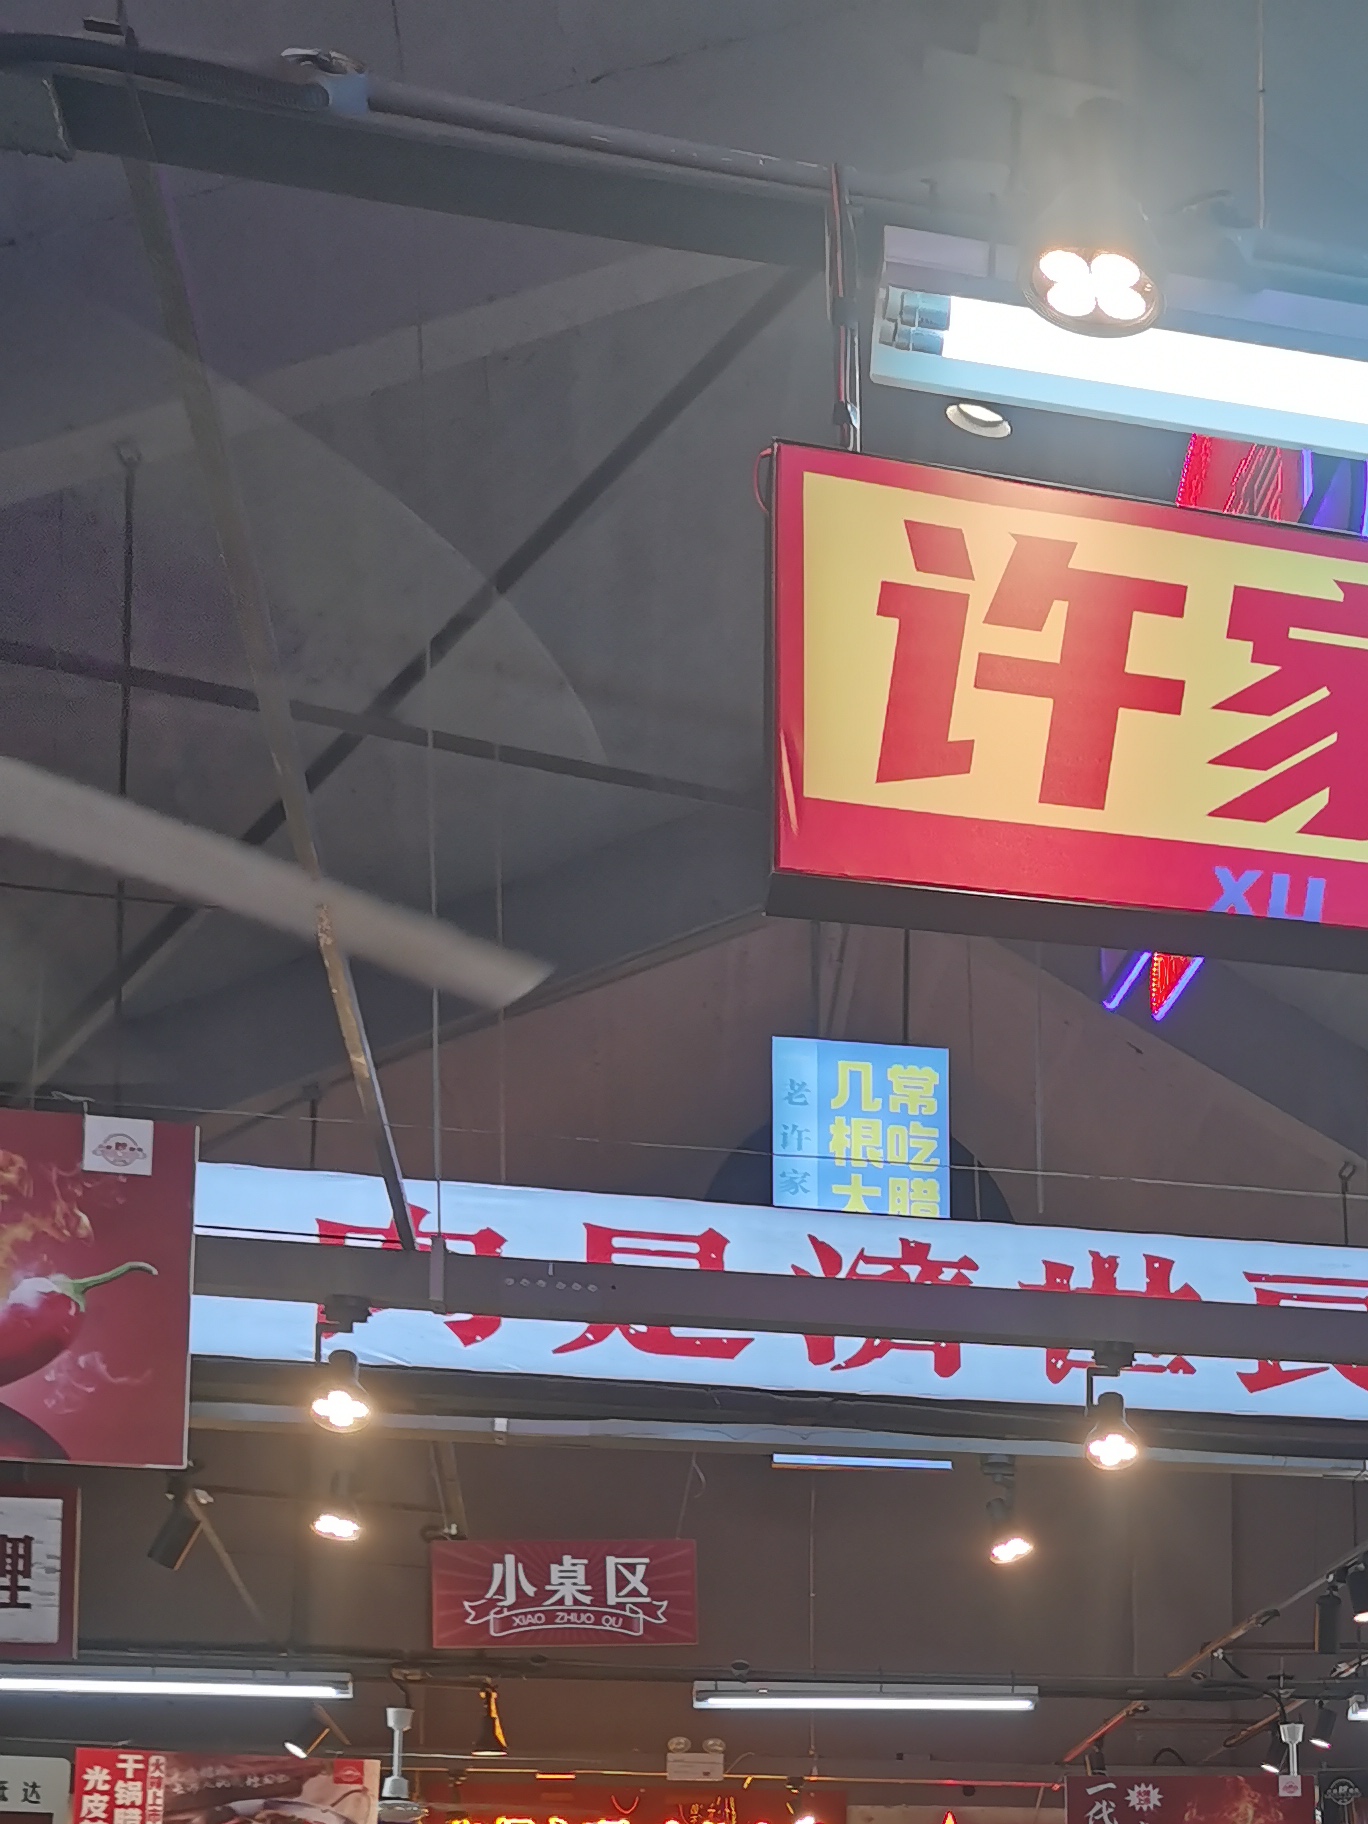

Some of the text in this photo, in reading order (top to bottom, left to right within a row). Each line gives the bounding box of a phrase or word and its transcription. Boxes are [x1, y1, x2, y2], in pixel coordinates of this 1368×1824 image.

[1212, 866, 1325, 923] XU
[779, 1078, 812, 1196] 老许家
[829, 1060, 884, 1213] 几根大
[886, 1064, 941, 1217] 常吃腊
[484, 1553, 652, 1607] 小桌区
[512, 1612, 624, 1628] XIAO ZHUO QU
